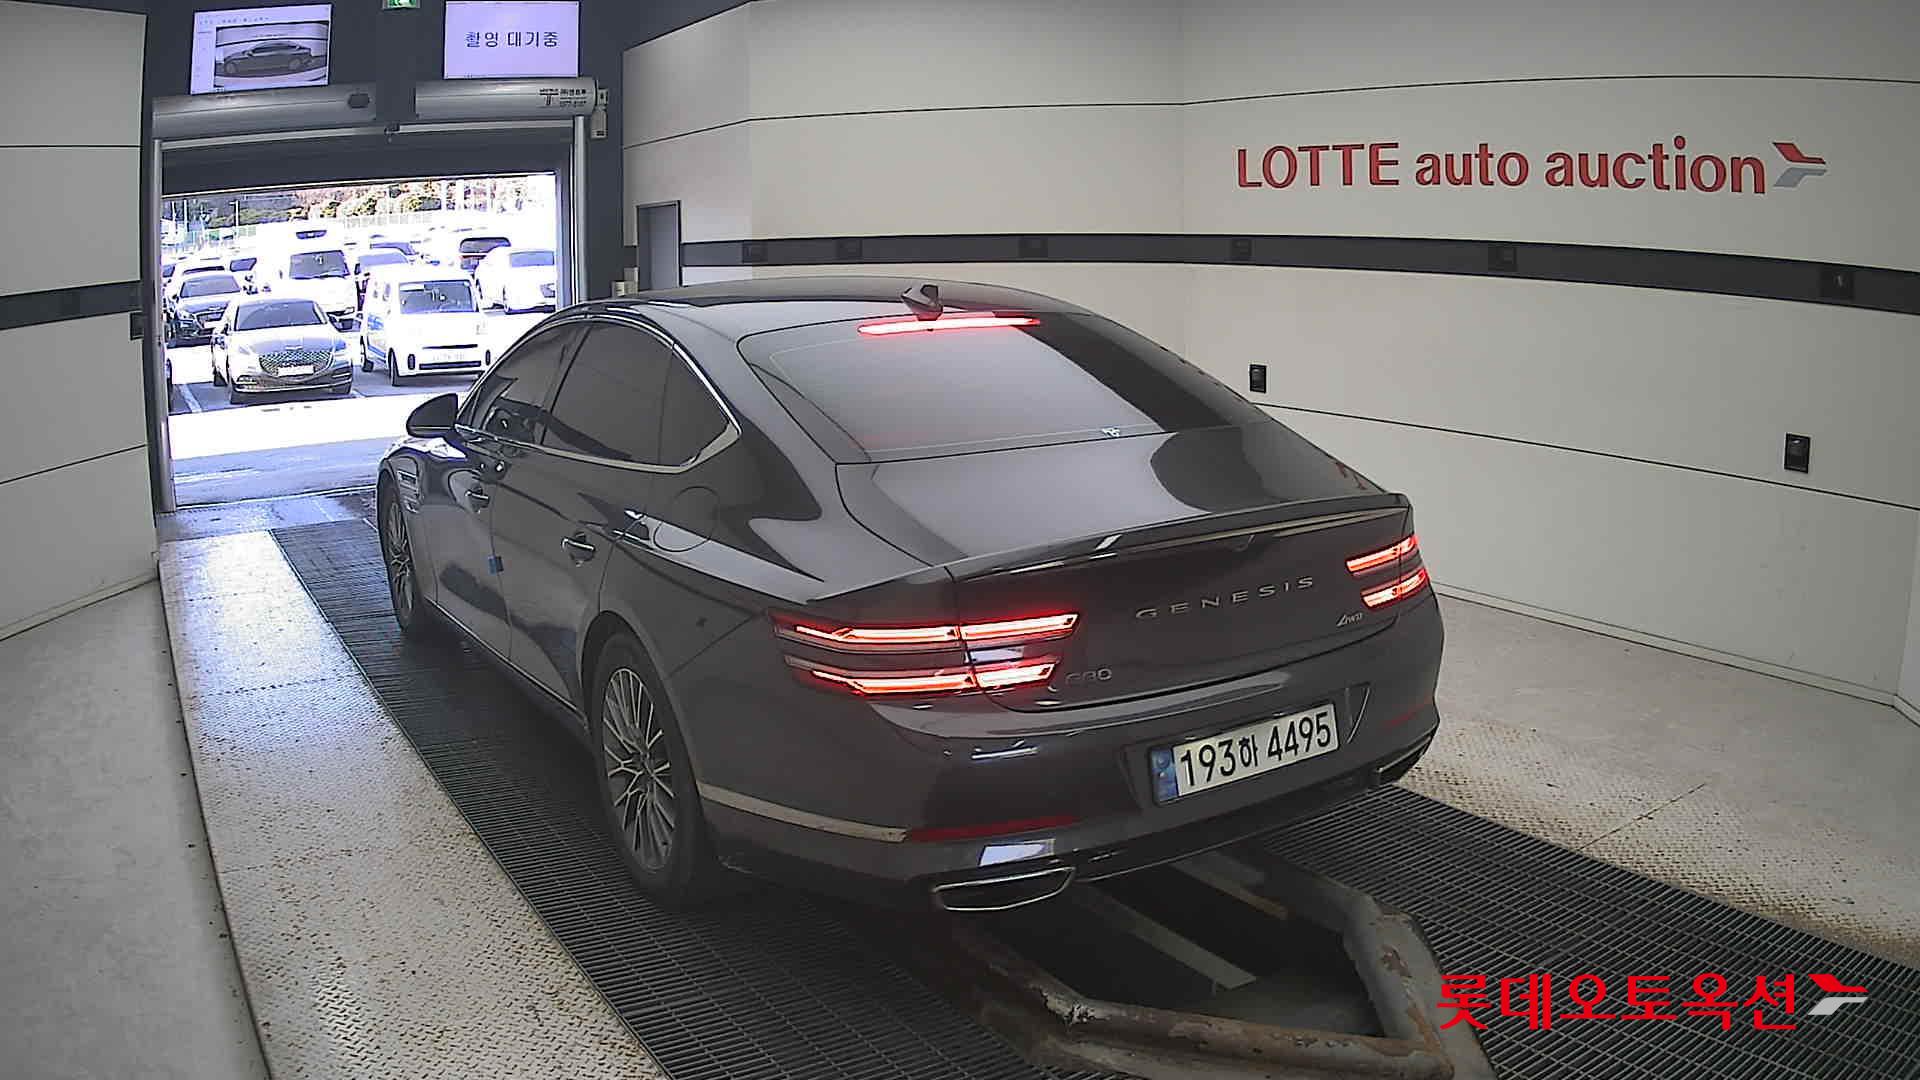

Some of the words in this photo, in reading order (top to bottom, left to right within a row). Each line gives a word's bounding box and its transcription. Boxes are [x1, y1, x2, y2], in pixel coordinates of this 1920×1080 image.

[507, 31, 559, 48] 대기중
[1237, 142, 1399, 188] LOTTE
[1415, 143, 1529, 187] auto
[1544, 135, 1766, 195] auction
[1135, 576, 1313, 619] GENESIS
[1180, 734, 1258, 786] 193하
[1267, 711, 1331, 762] 4495
